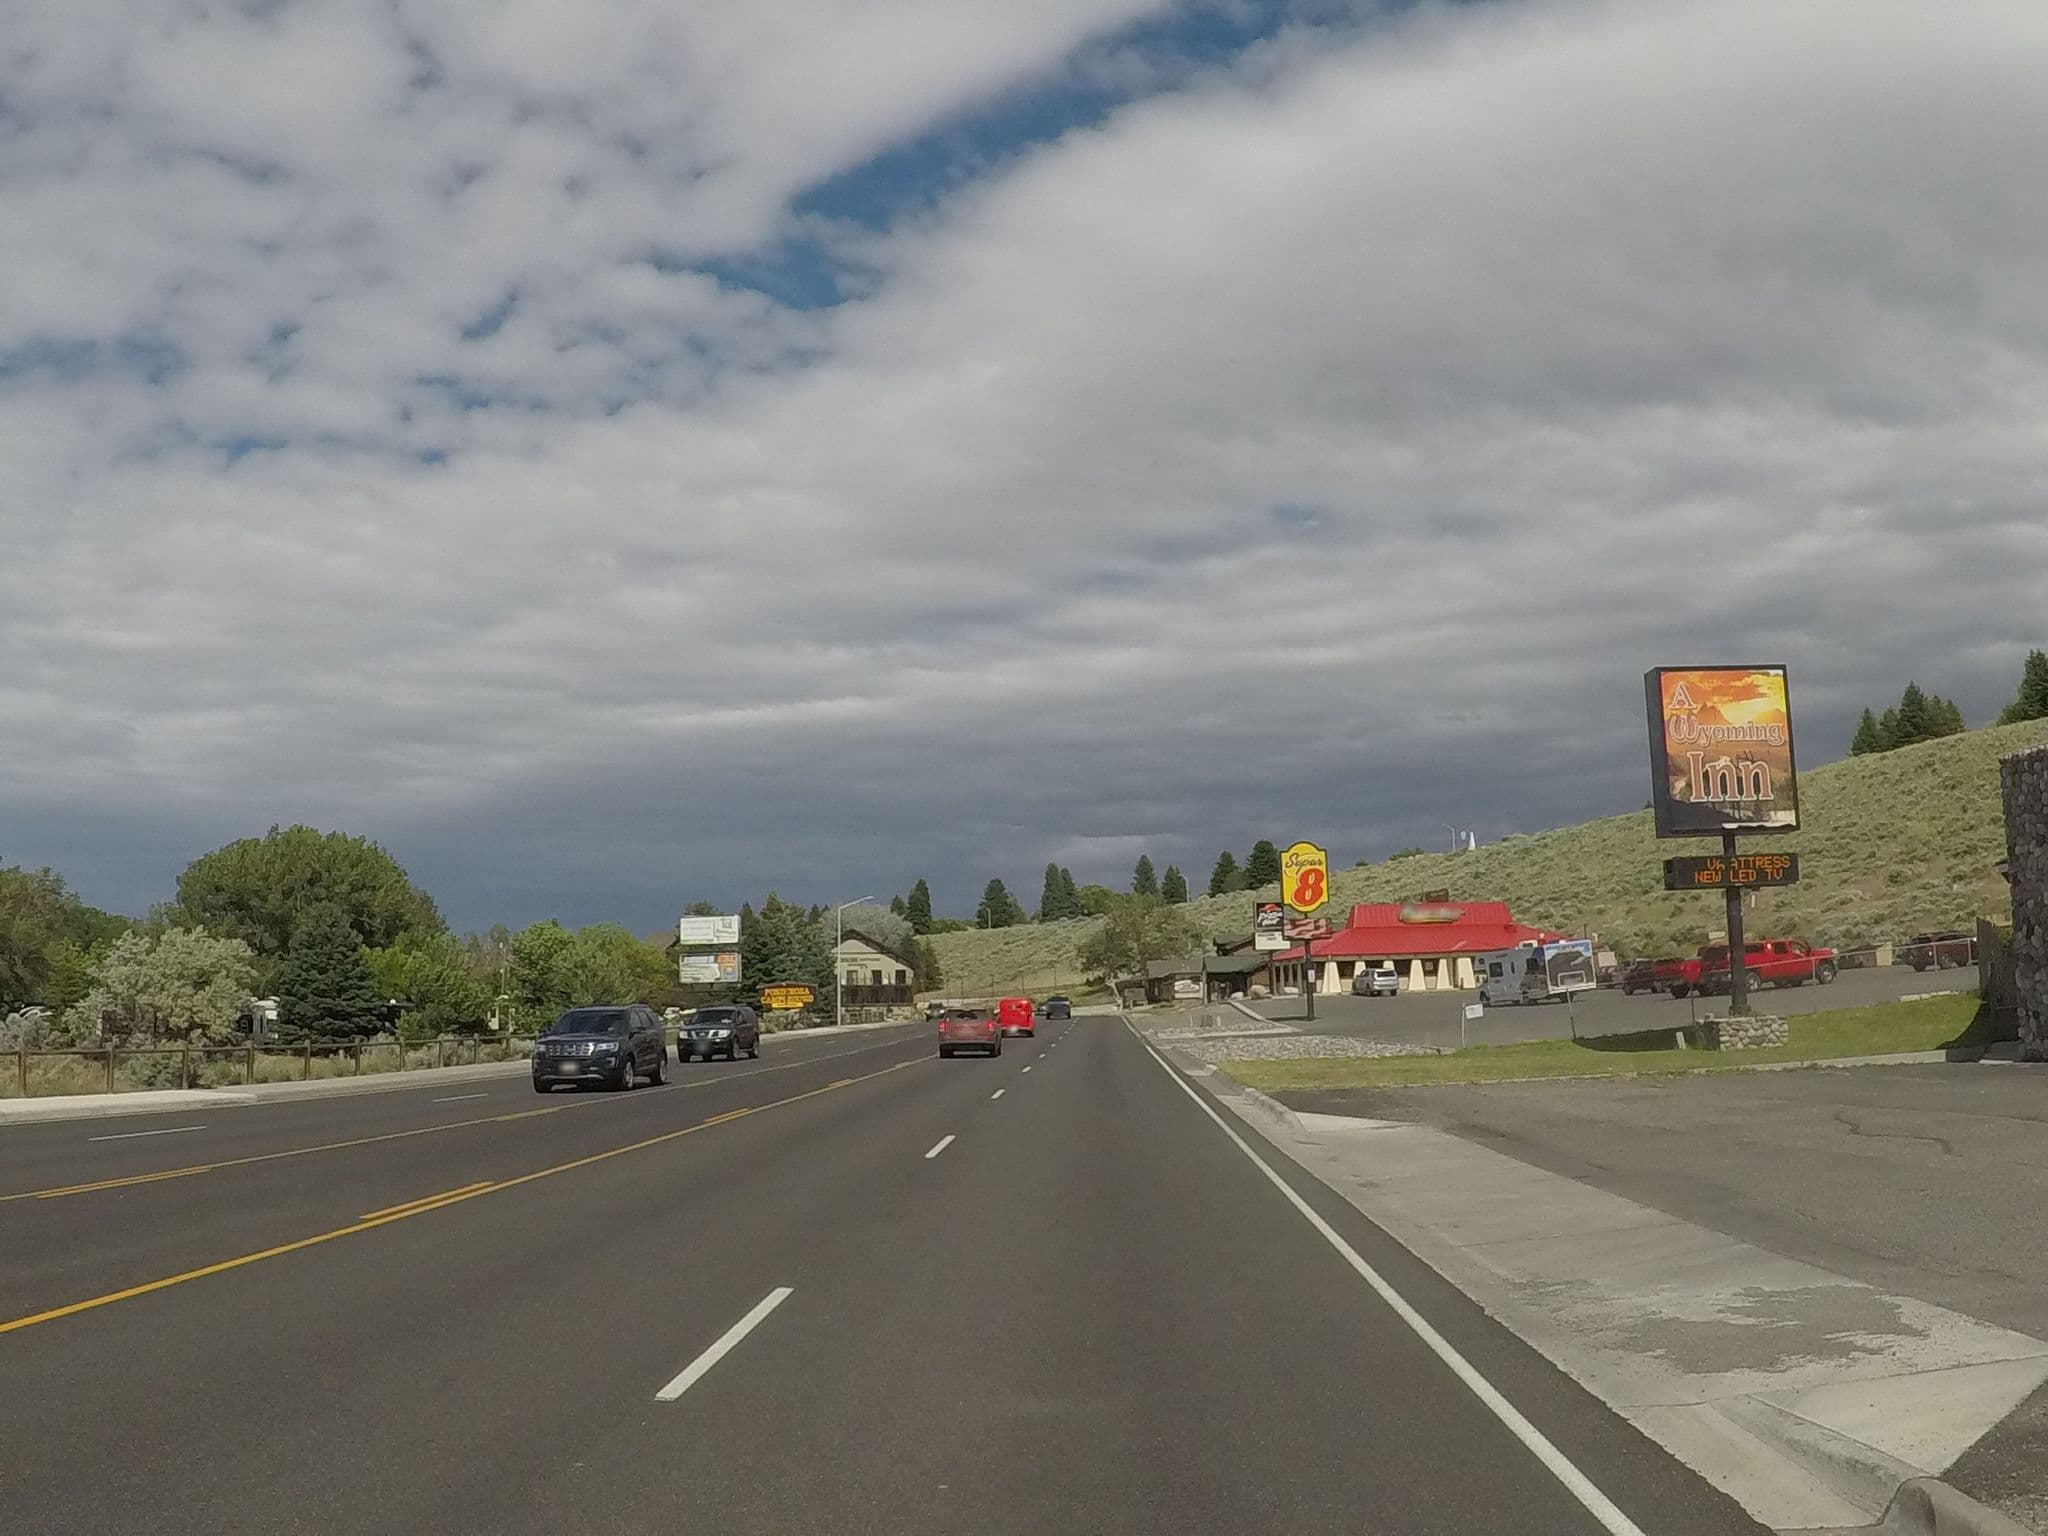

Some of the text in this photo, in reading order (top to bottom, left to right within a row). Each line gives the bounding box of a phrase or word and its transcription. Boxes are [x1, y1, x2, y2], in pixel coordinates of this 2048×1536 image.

[1669, 682, 1697, 710] A
[1669, 715, 1785, 747] Wyoming
[1687, 751, 1774, 802] Inn
[1292, 867, 1325, 907] 8
[1694, 868, 1784, 884] NEW LED TV
